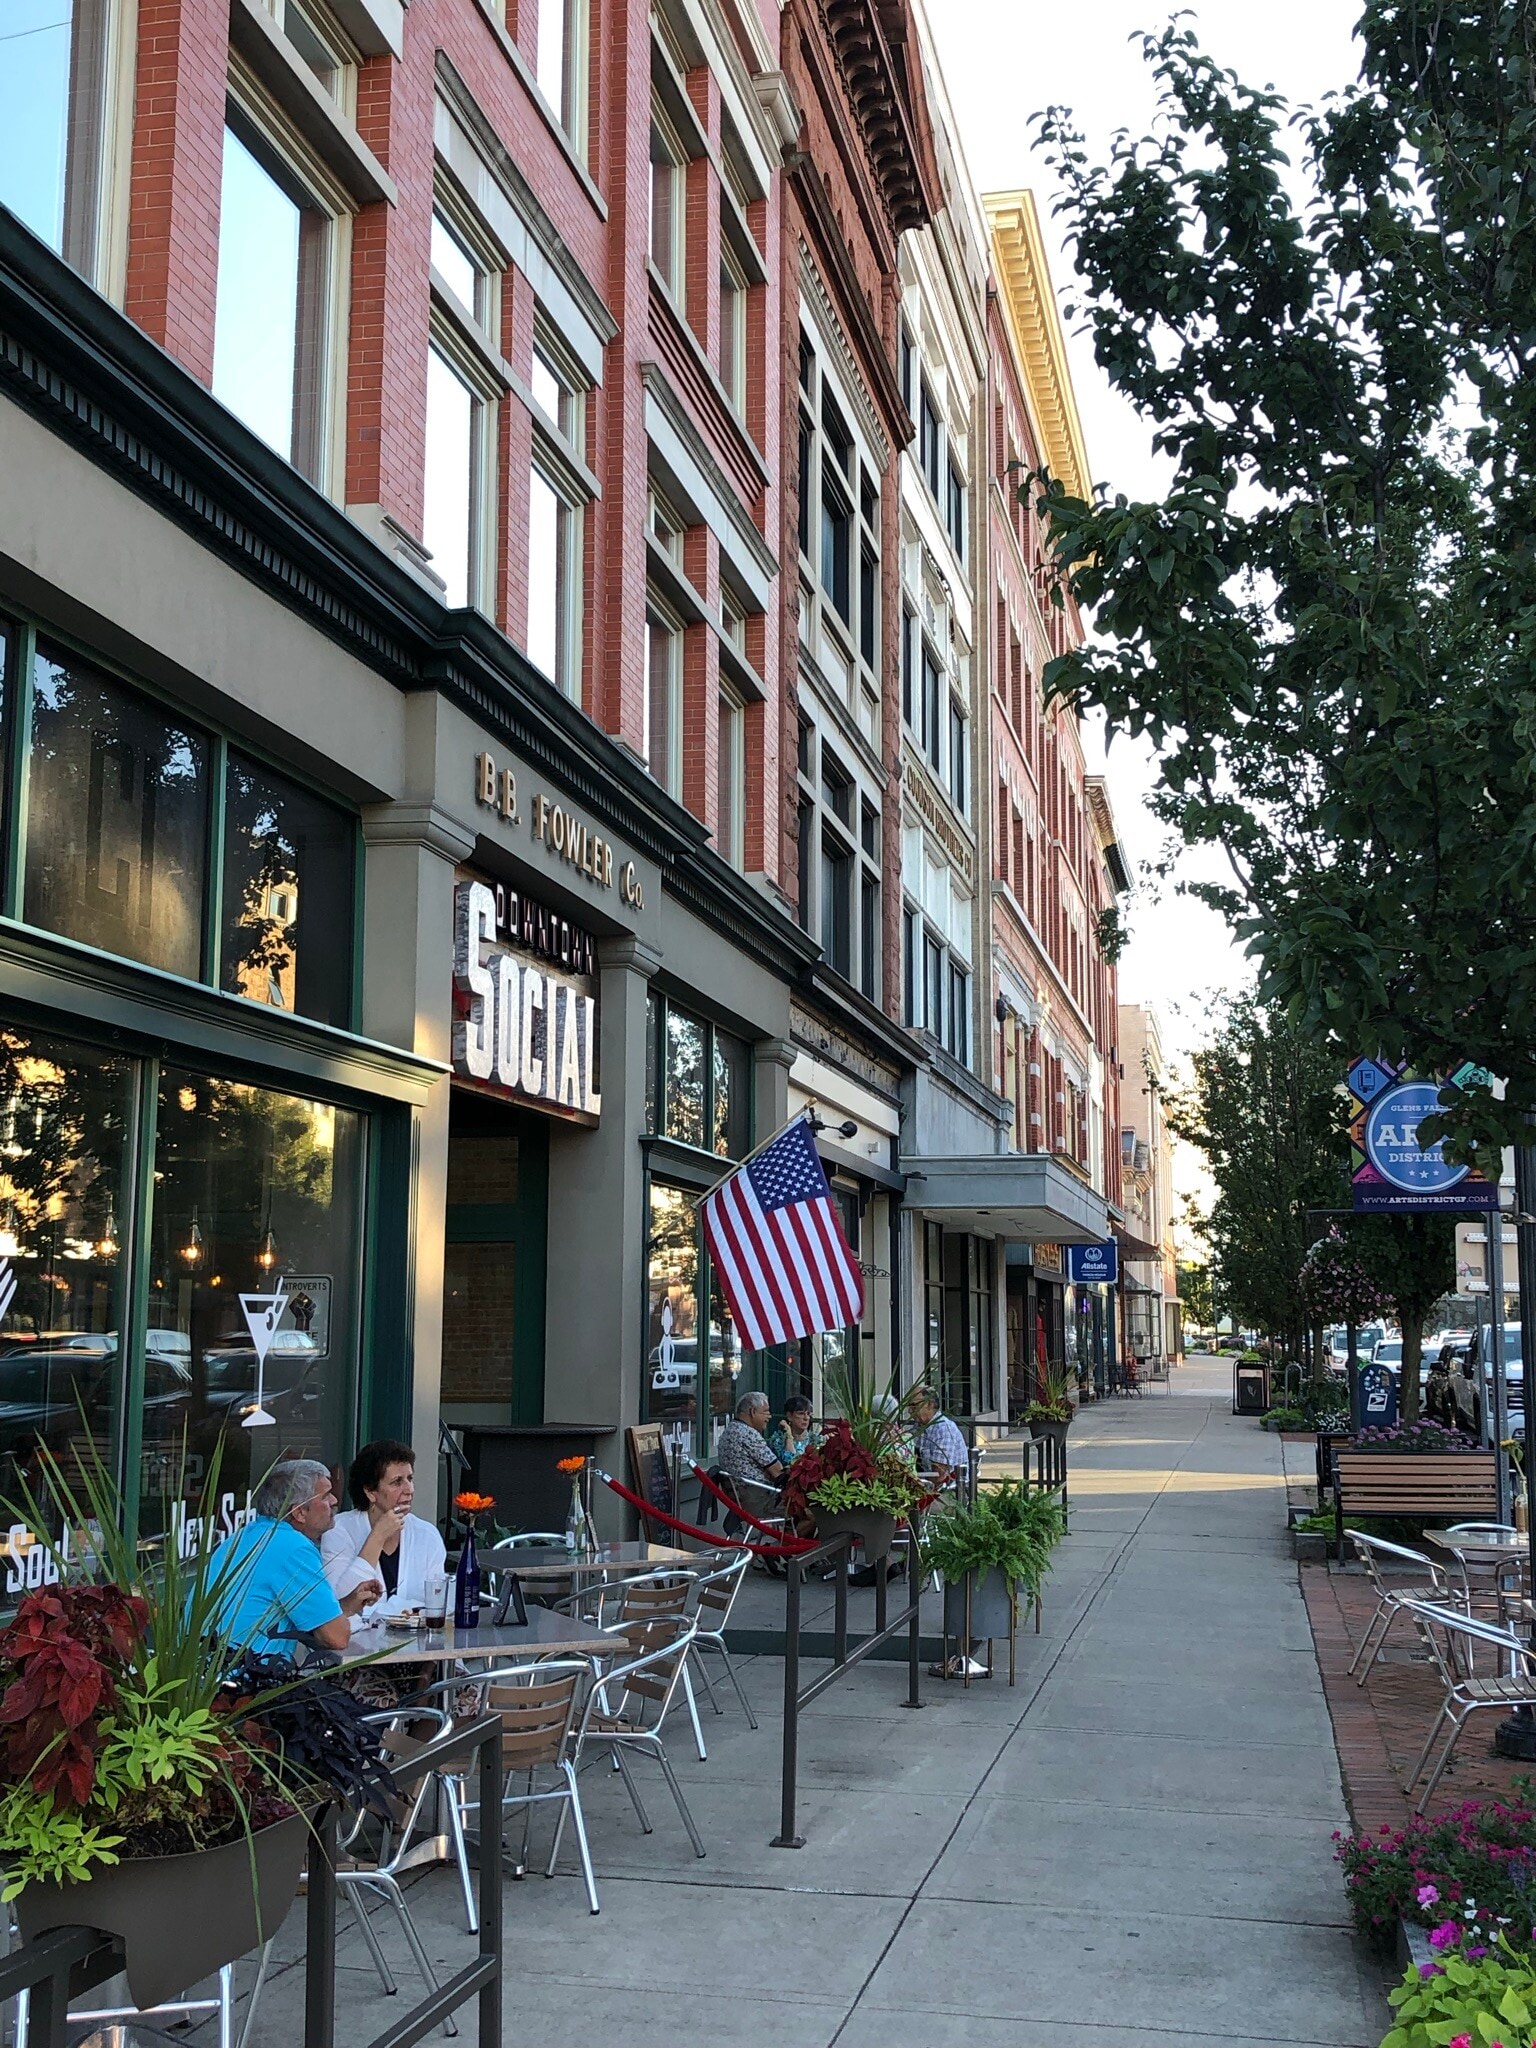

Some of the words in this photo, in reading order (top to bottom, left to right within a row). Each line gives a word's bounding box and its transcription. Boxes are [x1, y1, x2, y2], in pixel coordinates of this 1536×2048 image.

[478, 752, 522, 825] B.B.
[535, 793, 614, 889] FOWLER
[496, 882, 595, 976] DOWNTOWN
[456, 880, 602, 1115] SOCIAL
[1375, 1124, 1443, 1147] AR
[281, 1282, 327, 1291] NTROVERTS
[1081, 1262, 1108, 1270] Allstate
